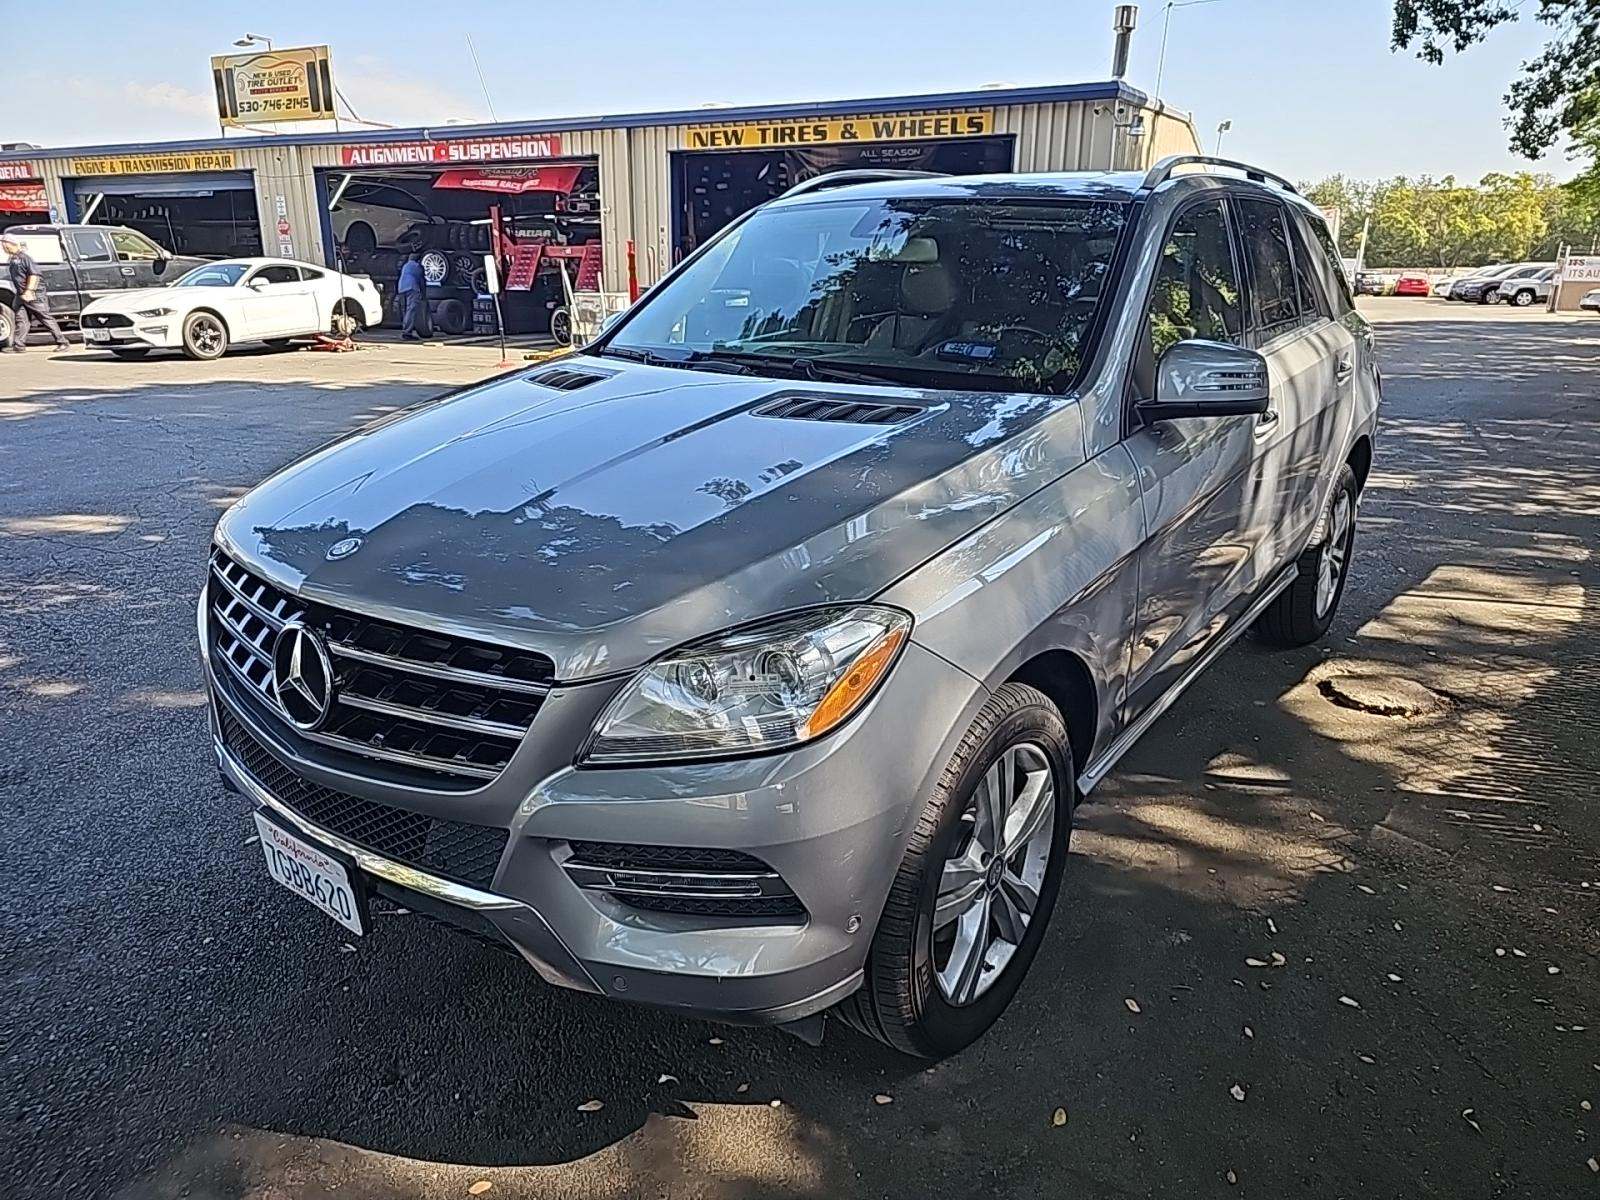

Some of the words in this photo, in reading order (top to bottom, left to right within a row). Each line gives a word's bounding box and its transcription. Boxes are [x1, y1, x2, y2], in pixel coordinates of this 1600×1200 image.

[247, 79, 265, 88] TIRE
[267, 76, 299, 86] OUTLET
[252, 72, 267, 80] NEW
[274, 69, 291, 77] USED
[239, 97, 309, 112] 530-746-2145
[693, 128, 745, 148] NEW
[757, 124, 828, 144] TIRES
[840, 123, 859, 140] &
[873, 115, 984, 138] WHEELS
[350, 145, 435, 164] ALIGNMENT
[449, 139, 551, 161] SUSPENSION
[860, 150, 878, 158] ALL
[881, 148, 921, 157] SEASON
[75, 161, 109, 175] ENGINE
[110, 160, 117, 172] &
[119, 157, 192, 173] TRANSMISSION
[195, 155, 232, 169] REPAIR
